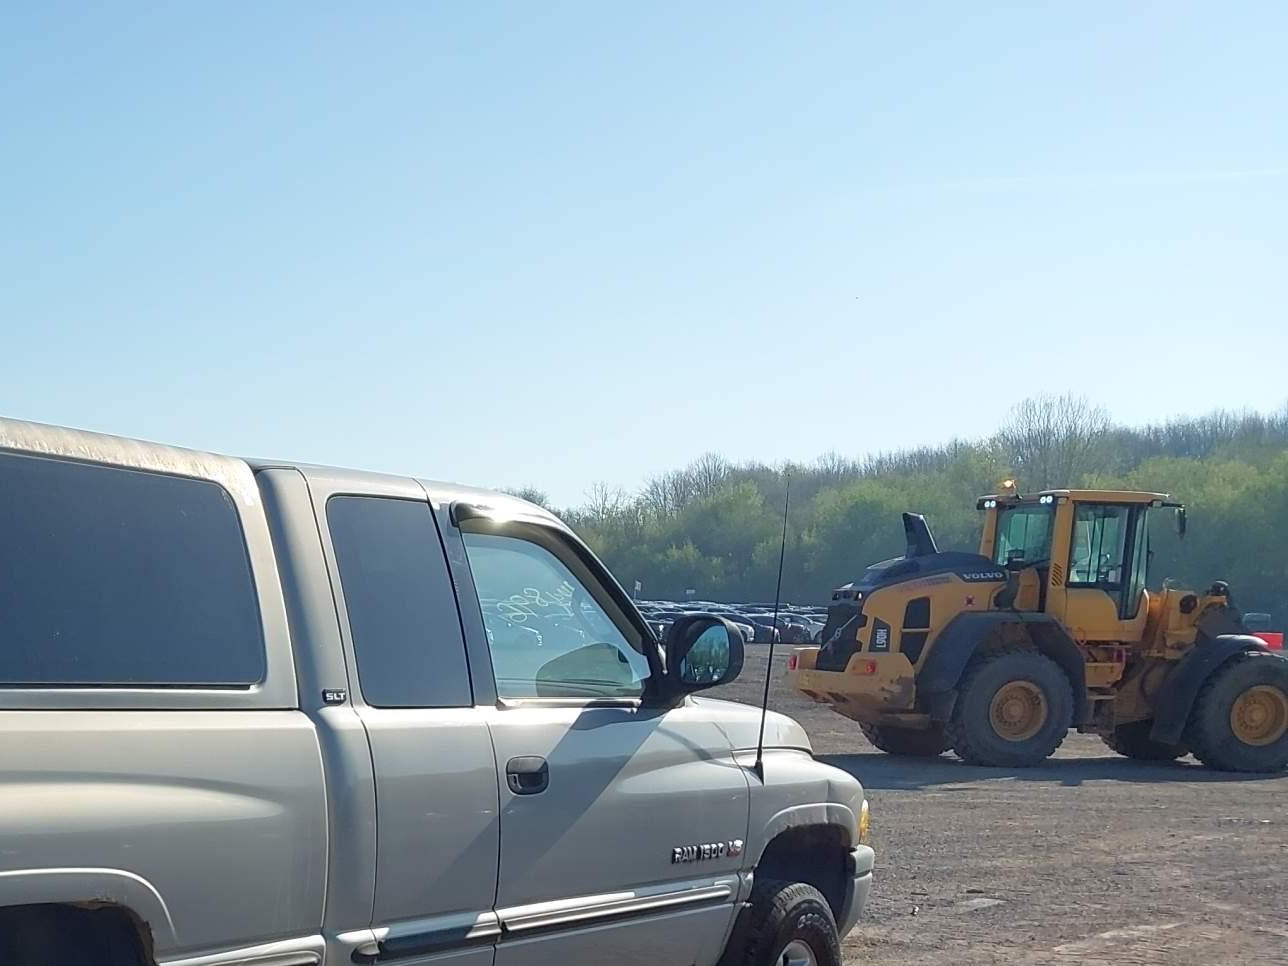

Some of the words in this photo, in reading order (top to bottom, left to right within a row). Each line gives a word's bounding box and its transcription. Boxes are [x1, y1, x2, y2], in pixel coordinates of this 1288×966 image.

[963, 571, 1004, 580] VOLVO
[325, 692, 346, 701] SLT
[673, 846, 697, 864] RAM
[699, 843, 725, 860] 1500
